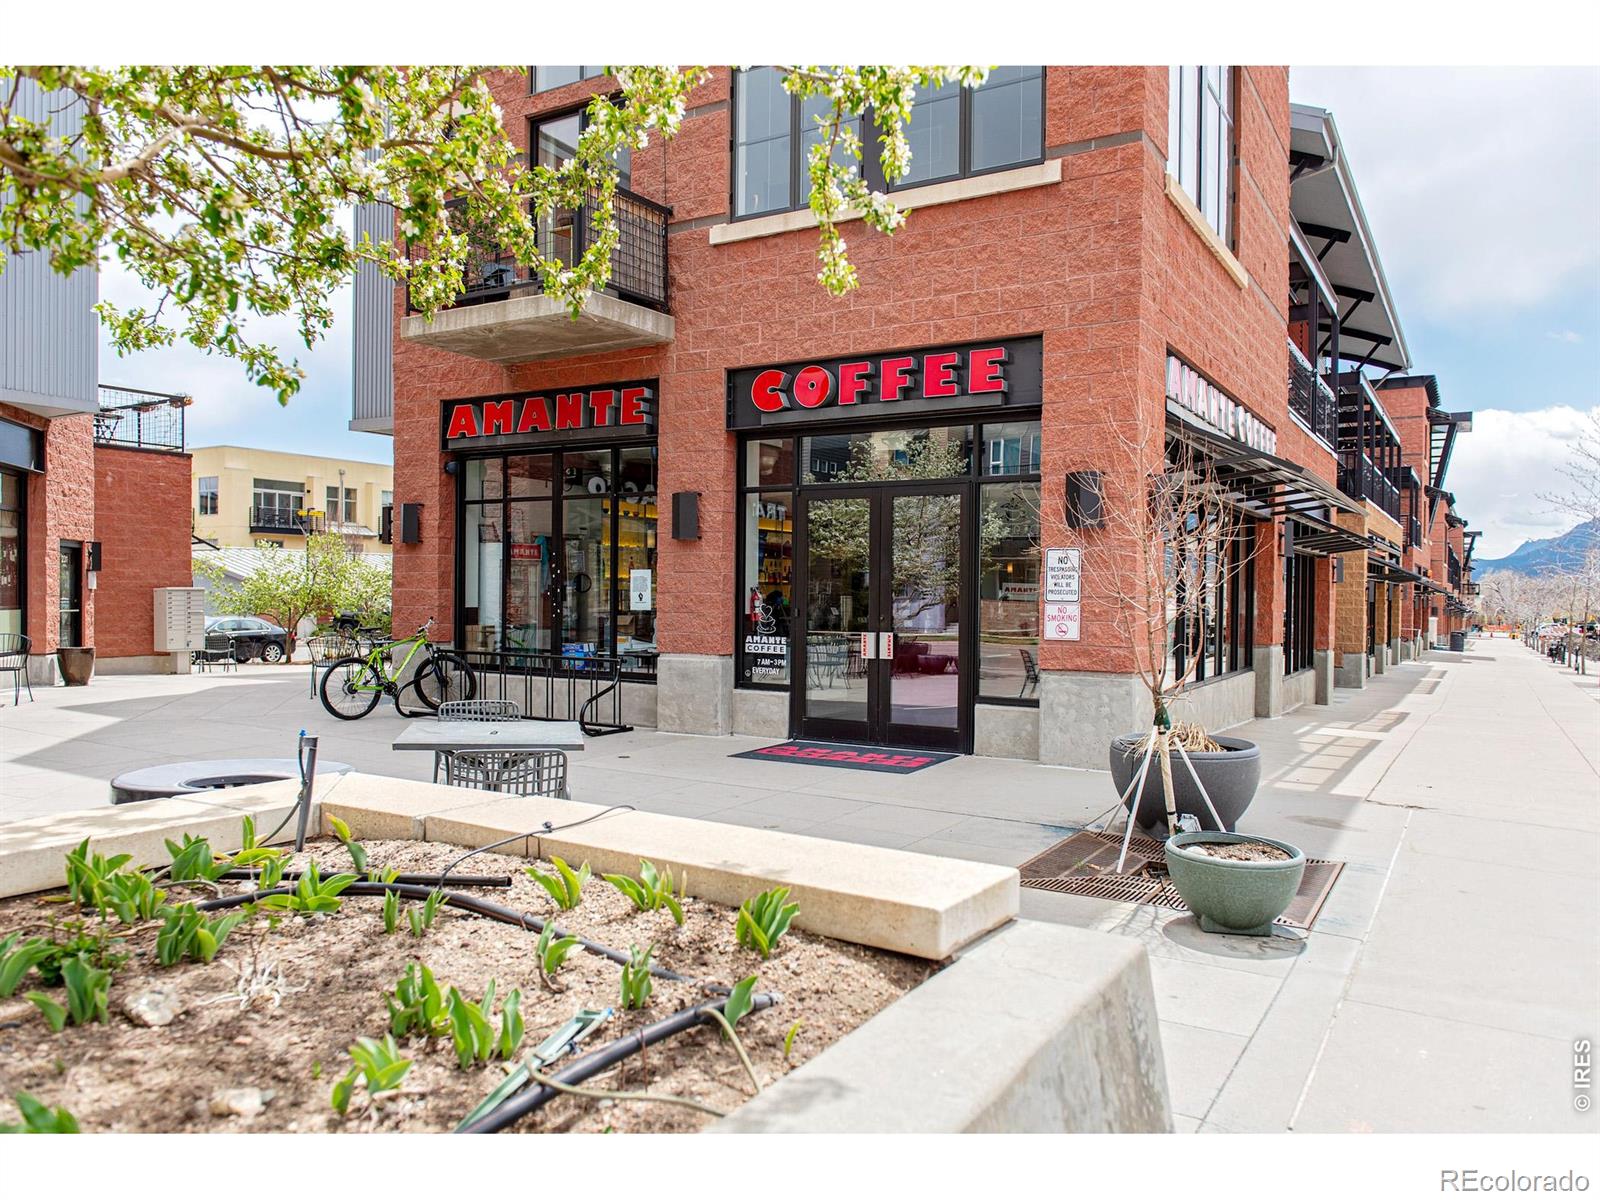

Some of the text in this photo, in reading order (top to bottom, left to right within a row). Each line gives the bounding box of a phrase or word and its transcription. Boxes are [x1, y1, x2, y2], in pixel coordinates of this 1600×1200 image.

[751, 347, 1008, 412] COFFEE
[447, 387, 652, 438] AMANTE
[1058, 556, 1068, 565] NO
[1058, 606, 1067, 614] NO
[1047, 614, 1077, 622] SMOKING
[746, 635, 787, 644] AMANTE
[747, 644, 785, 653] COFFEE
[752, 666, 780, 675] EVERYDAY
